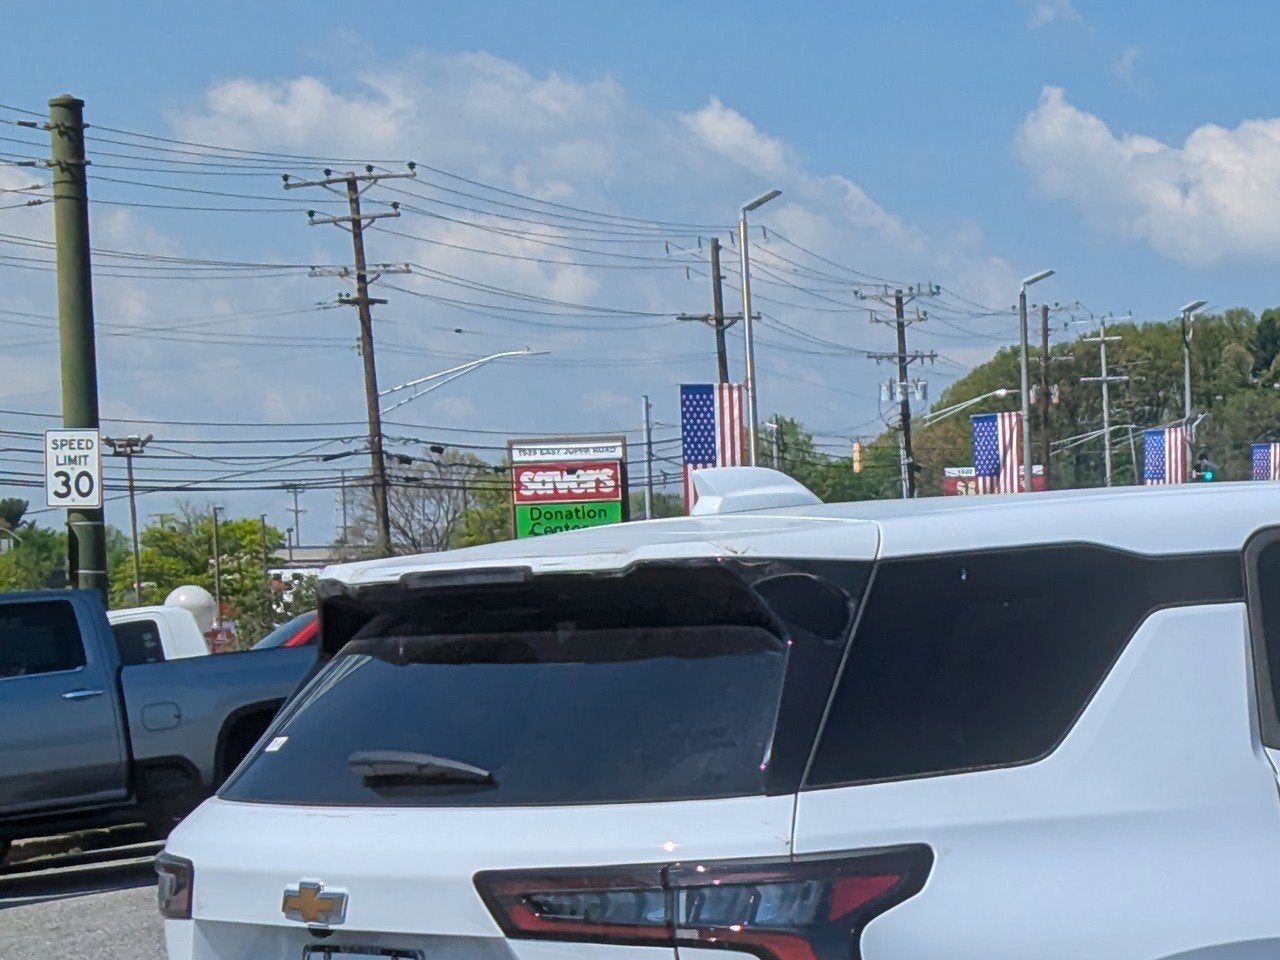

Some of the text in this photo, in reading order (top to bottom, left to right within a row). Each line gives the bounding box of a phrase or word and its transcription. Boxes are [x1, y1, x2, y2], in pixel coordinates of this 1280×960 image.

[51, 438, 94, 451] SPEED
[56, 454, 90, 466] LIMIT
[52, 470, 94, 499] 30
[529, 506, 608, 522] Donation
